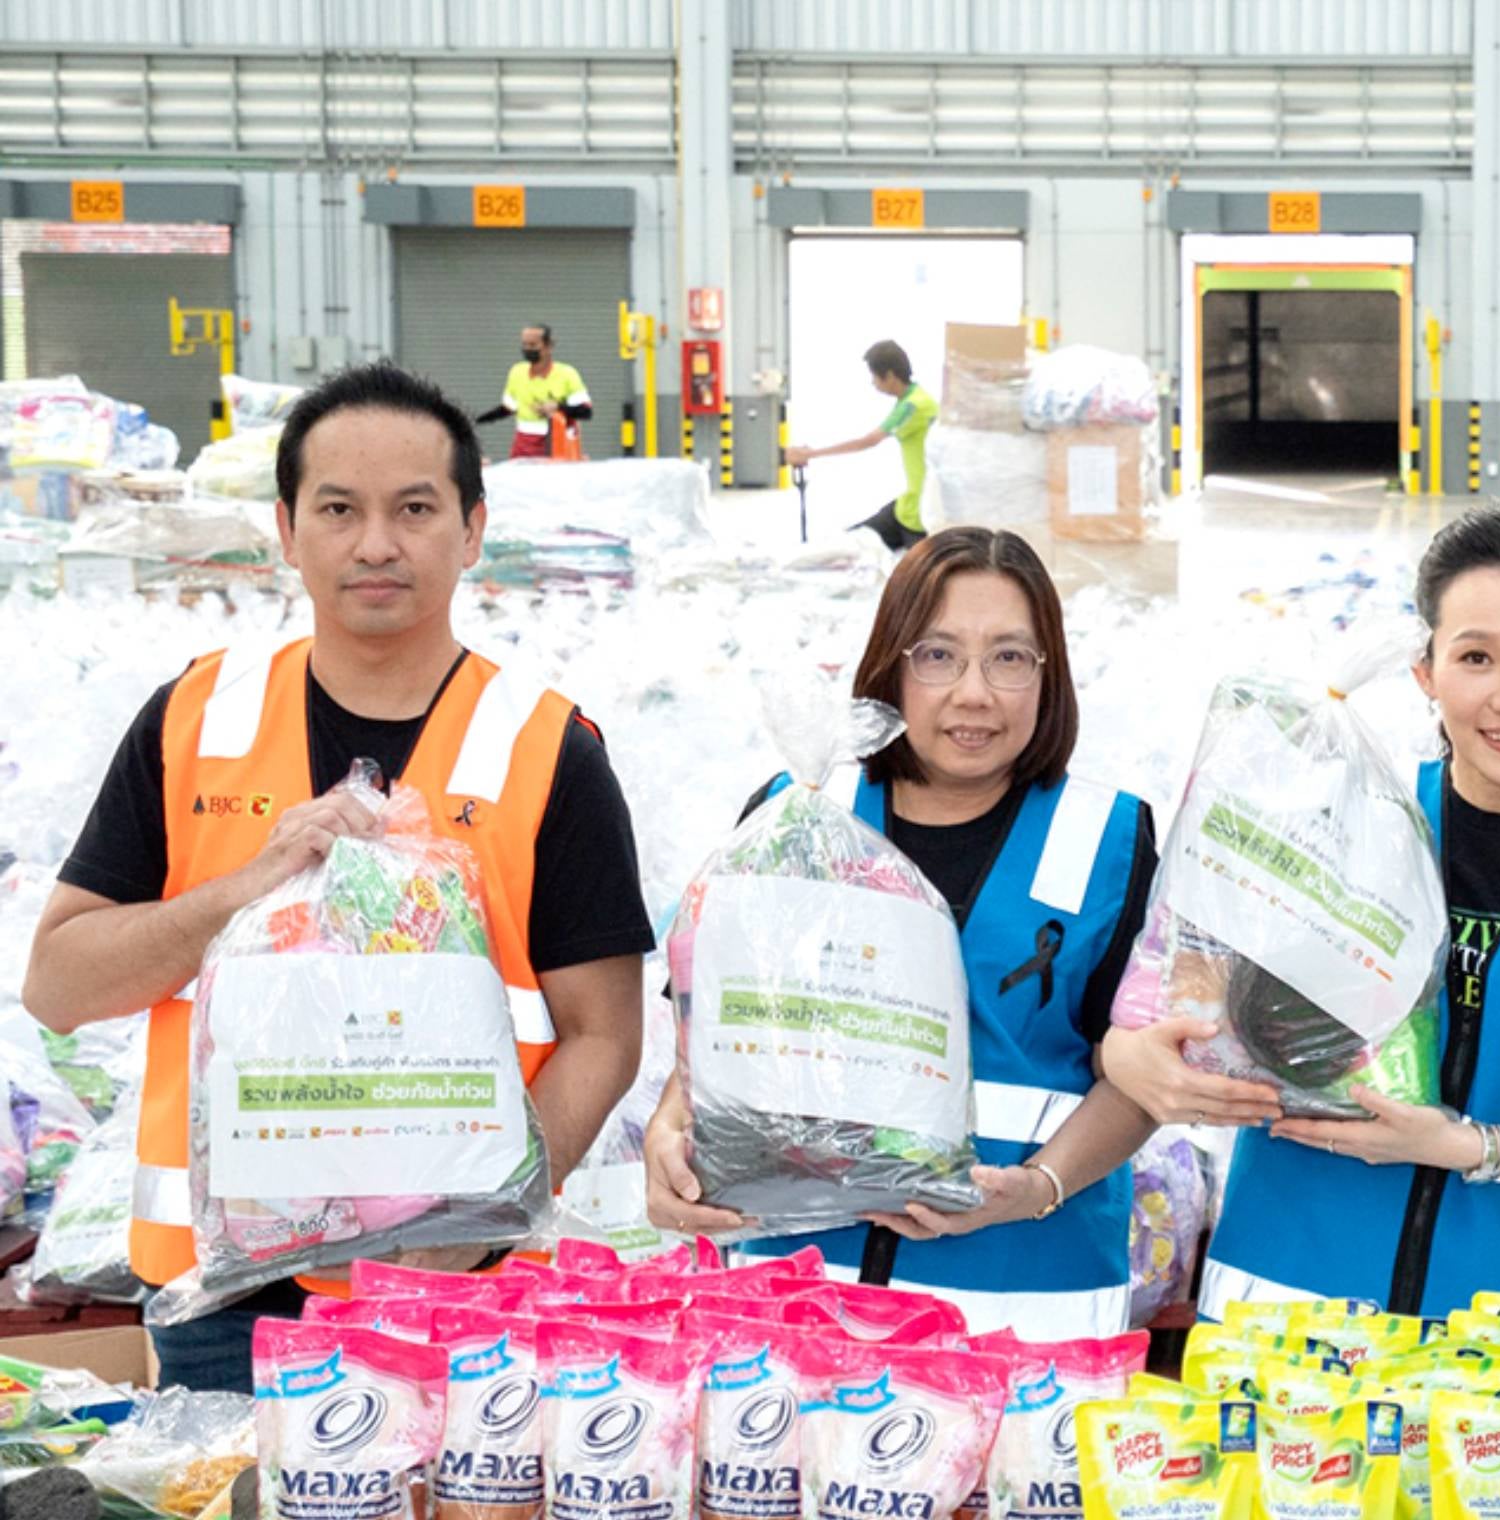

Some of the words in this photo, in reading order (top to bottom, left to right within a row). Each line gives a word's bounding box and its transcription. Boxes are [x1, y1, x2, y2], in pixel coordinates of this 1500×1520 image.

[76, 190, 119, 212] B25
[478, 195, 521, 217] B26
[876, 198, 918, 220] B27
[1274, 202, 1315, 223] B28
[209, 796, 242, 818] BJC
[1113, 1432, 1161, 1457] HAPPY
[1116, 1443, 1164, 1474] PRICE
